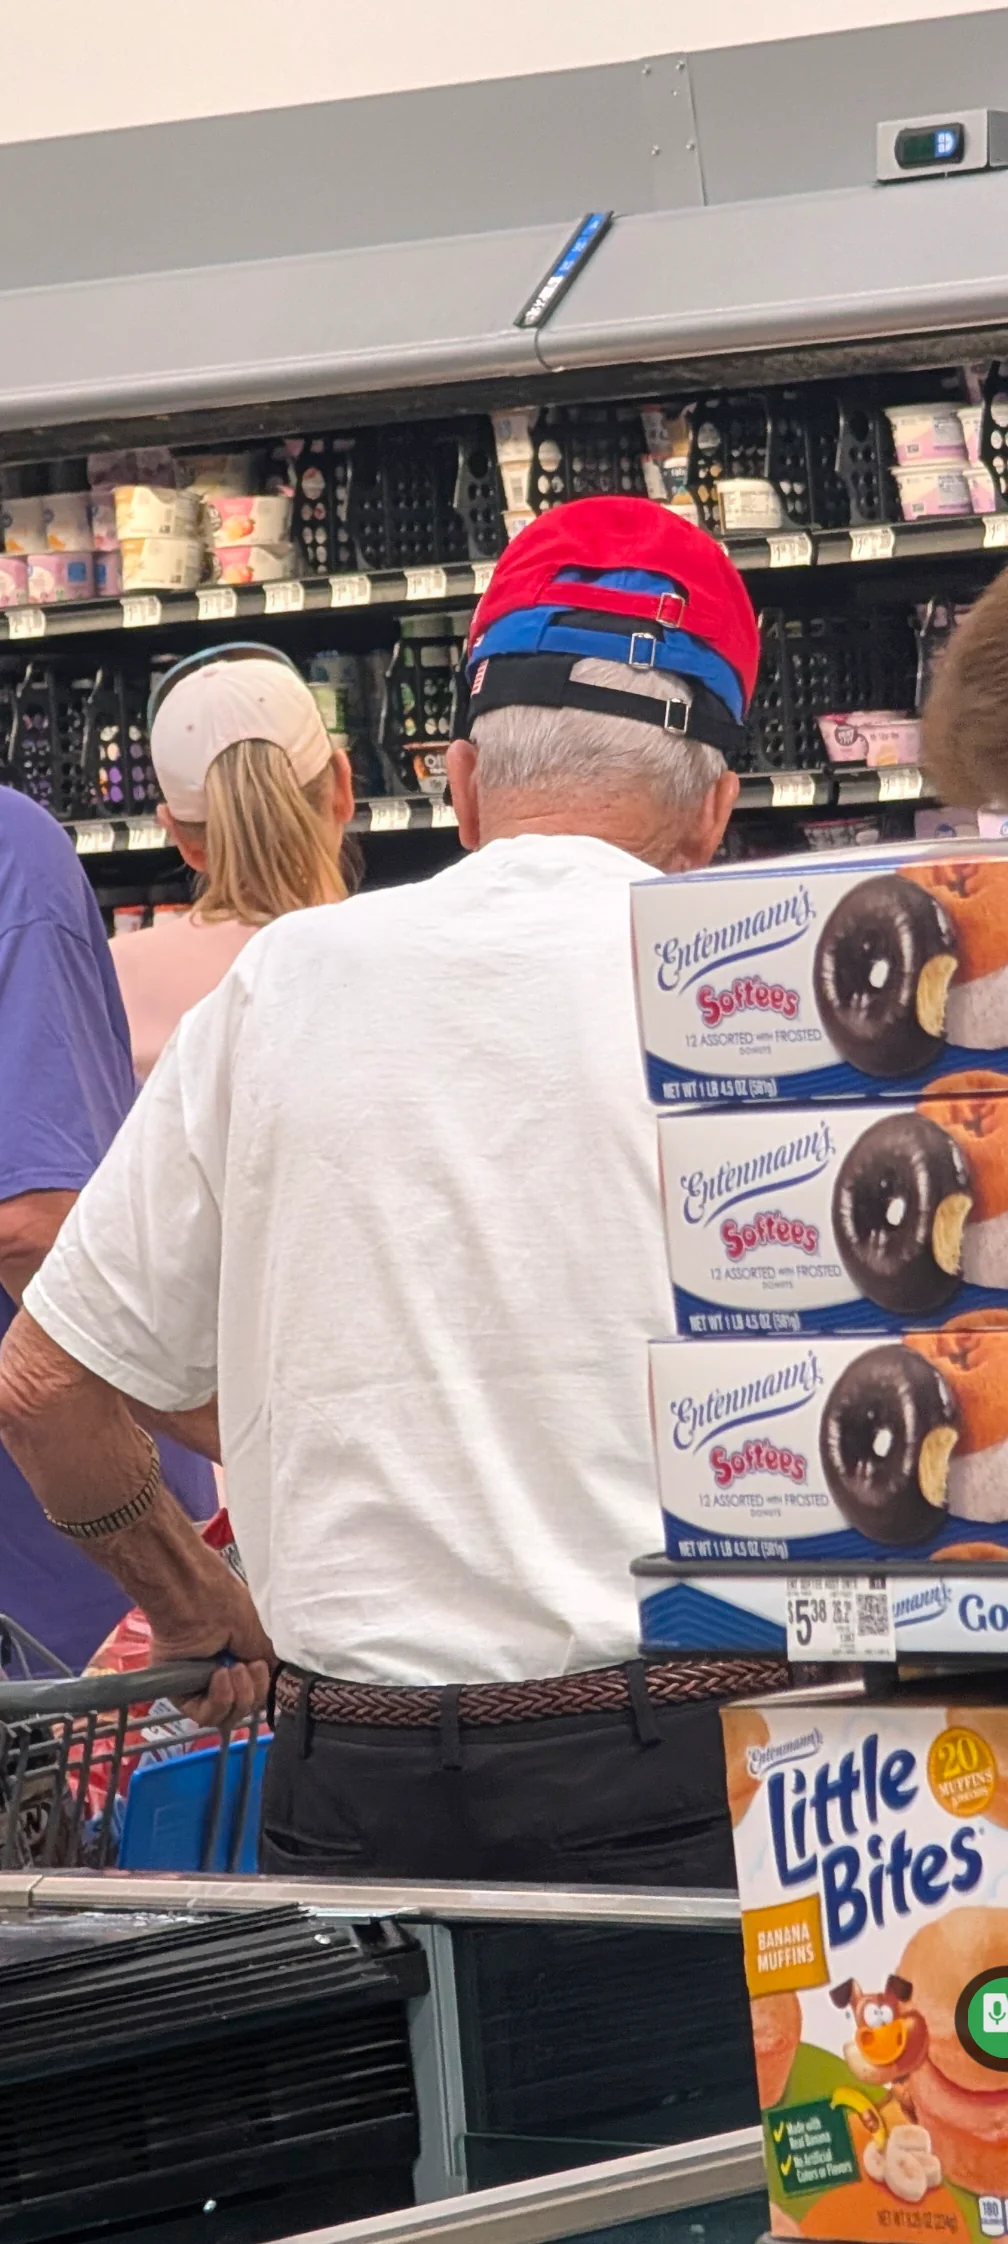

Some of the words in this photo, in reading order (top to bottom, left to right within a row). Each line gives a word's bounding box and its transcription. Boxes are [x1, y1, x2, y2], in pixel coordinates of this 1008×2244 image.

[654, 884, 817, 991] Entenmann's
[685, 1034, 697, 1047] 12
[700, 1032, 753, 1046] ASSORTED
[774, 1029, 822, 1042] FROSTED
[662, 1082, 680, 1099] NET
[681, 1080, 697, 1098] WT
[706, 1081, 719, 1097] LB
[735, 1079, 748, 1096] OZ
[680, 1121, 836, 1224] Entenmann's
[710, 1268, 721, 1280] 12
[724, 1266, 776, 1280] ASSORTED
[796, 1264, 842, 1278] FROSTED
[689, 1315, 707, 1332] NET
[707, 1314, 723, 1331] WT
[730, 1313, 744, 1330] LB
[759, 1313, 772, 1329] OZ
[670, 1350, 824, 1450] Entenmann's
[698, 1494, 710, 1507] 12
[713, 1493, 764, 1507] ASSORTED
[784, 1493, 829, 1506] FROSTED
[678, 1540, 696, 1557] NET
[696, 1540, 712, 1557] WT
[720, 1540, 732, 1557] LB
[747, 1540, 760, 1557] OZ
[938, 1738, 978, 1780] 20
[939, 1769, 993, 1797] MUFFINS
[767, 1733, 919, 1888] Little
[822, 1826, 983, 1951] Bites
[757, 1922, 810, 1950] BANANA
[757, 1946, 815, 1973] MUFFINS
[789, 2136, 805, 2150] Real
